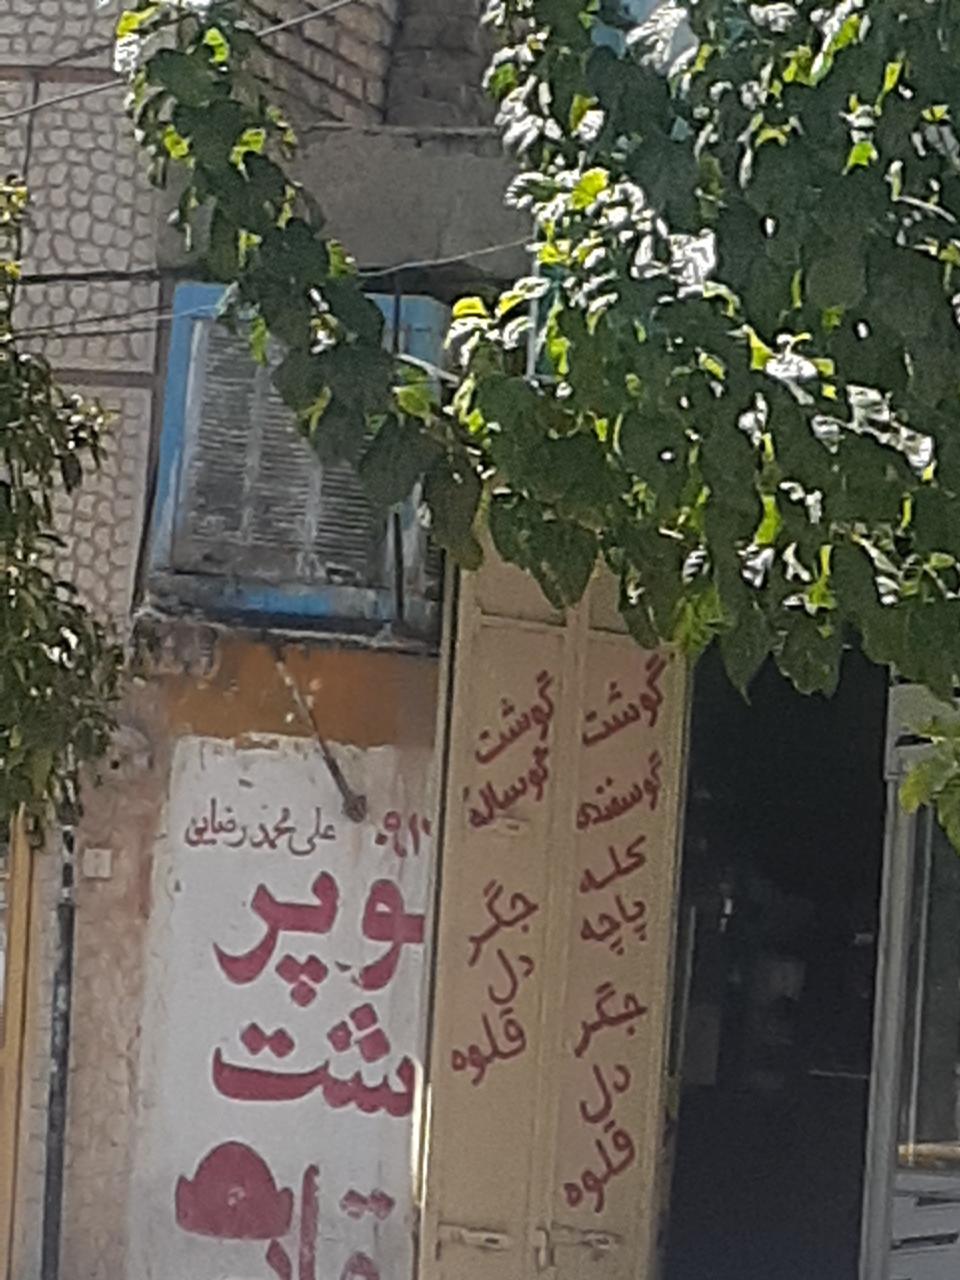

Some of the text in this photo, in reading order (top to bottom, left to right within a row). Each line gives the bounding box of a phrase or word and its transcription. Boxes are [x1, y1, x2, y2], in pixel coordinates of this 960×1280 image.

[475, 670, 554, 764] گوشت
[582, 654, 667, 745] گوشت
[185, 798, 336, 855] علی محمد رضایی
[469, 747, 549, 828] گوساله
[580, 835, 646, 893] کله
[213, 871, 424, 1006] وپر
[469, 879, 538, 967] جگر
[581, 894, 647, 957] پاچه
[488, 949, 535, 1005] دل
[452, 1007, 526, 1086] قلوه
[574, 981, 648, 1058] جگر
[580, 1064, 631, 1123] دل
[564, 1120, 636, 1213] قلوه
